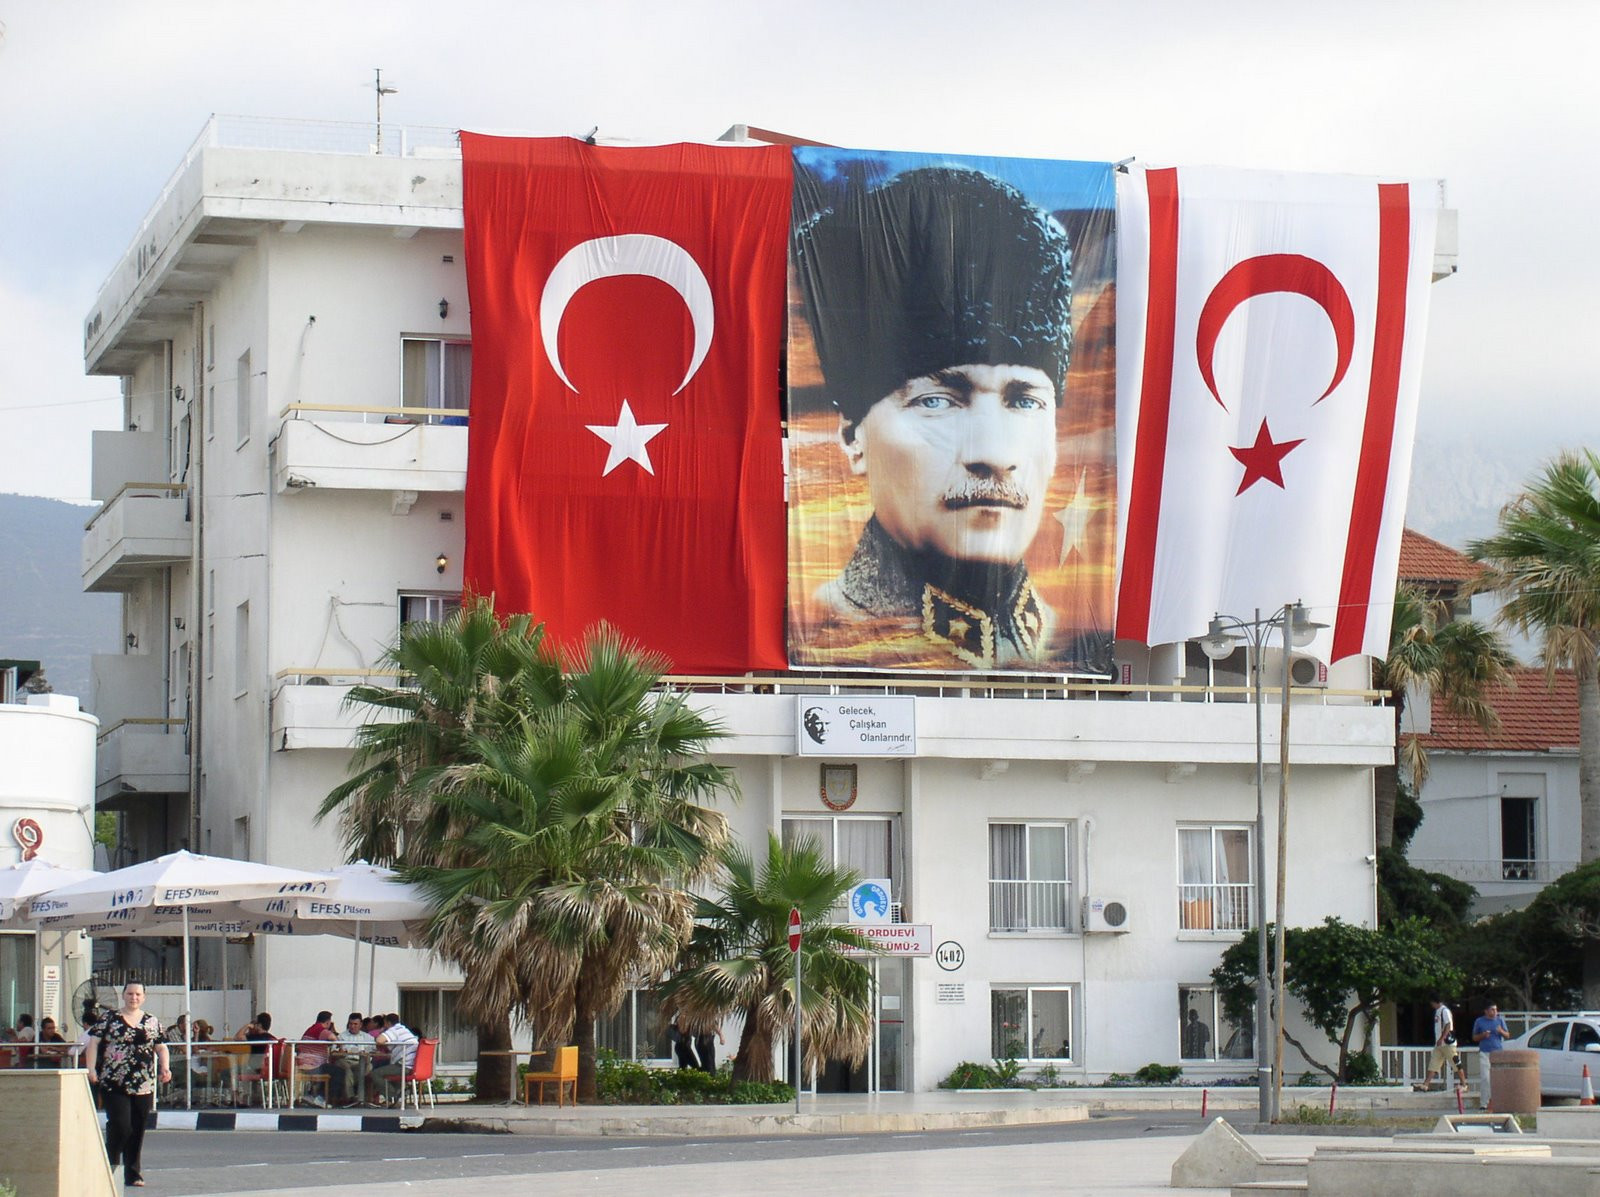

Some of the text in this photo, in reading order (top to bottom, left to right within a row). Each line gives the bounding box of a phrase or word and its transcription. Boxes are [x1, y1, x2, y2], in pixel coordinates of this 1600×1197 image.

[838, 705, 876, 716] Gelecek,
[849, 720, 887, 730] Çalışkan
[859, 732, 913, 742] Olanlarındır.
[164, 888, 219, 900] EFES Pilsen
[31, 900, 51, 912] EFES
[154, 905, 212, 915] EFES Pilsen
[310, 903, 371, 914] EFES Pilsen
[868, 928, 915, 937] ORDUEVİ
[940, 950, 960, 963] 1402
